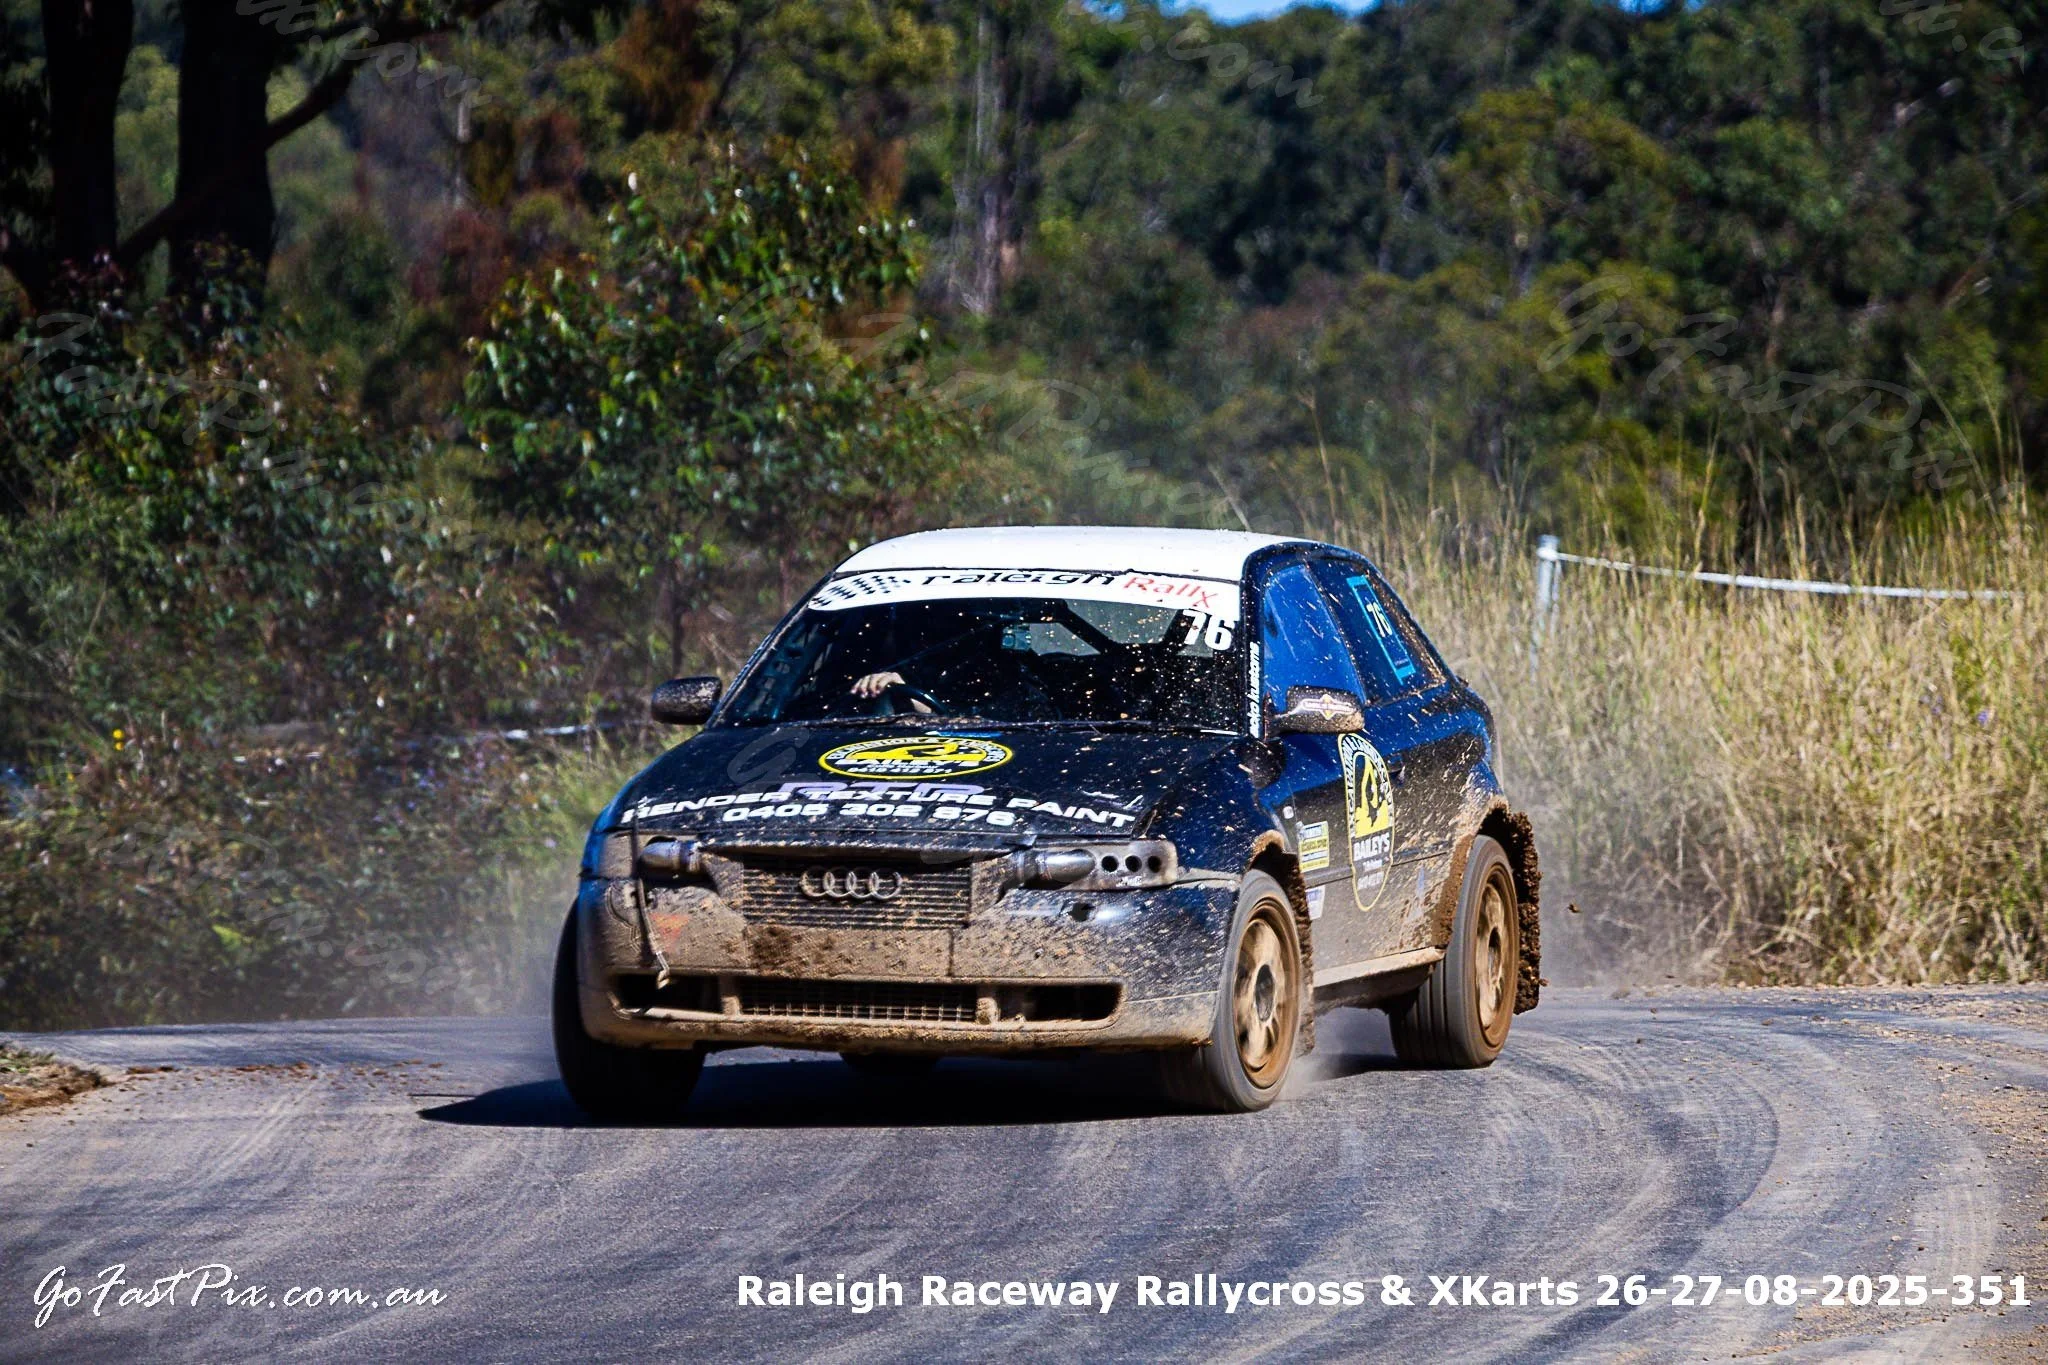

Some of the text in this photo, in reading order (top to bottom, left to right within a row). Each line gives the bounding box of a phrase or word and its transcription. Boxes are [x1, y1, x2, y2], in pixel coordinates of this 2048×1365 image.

[1183, 609, 1236, 651] 76
[620, 790, 1136, 828] RENDER TEXTURE PAINT
[839, 803, 923, 818] 302
[932, 806, 1016, 827] 876
